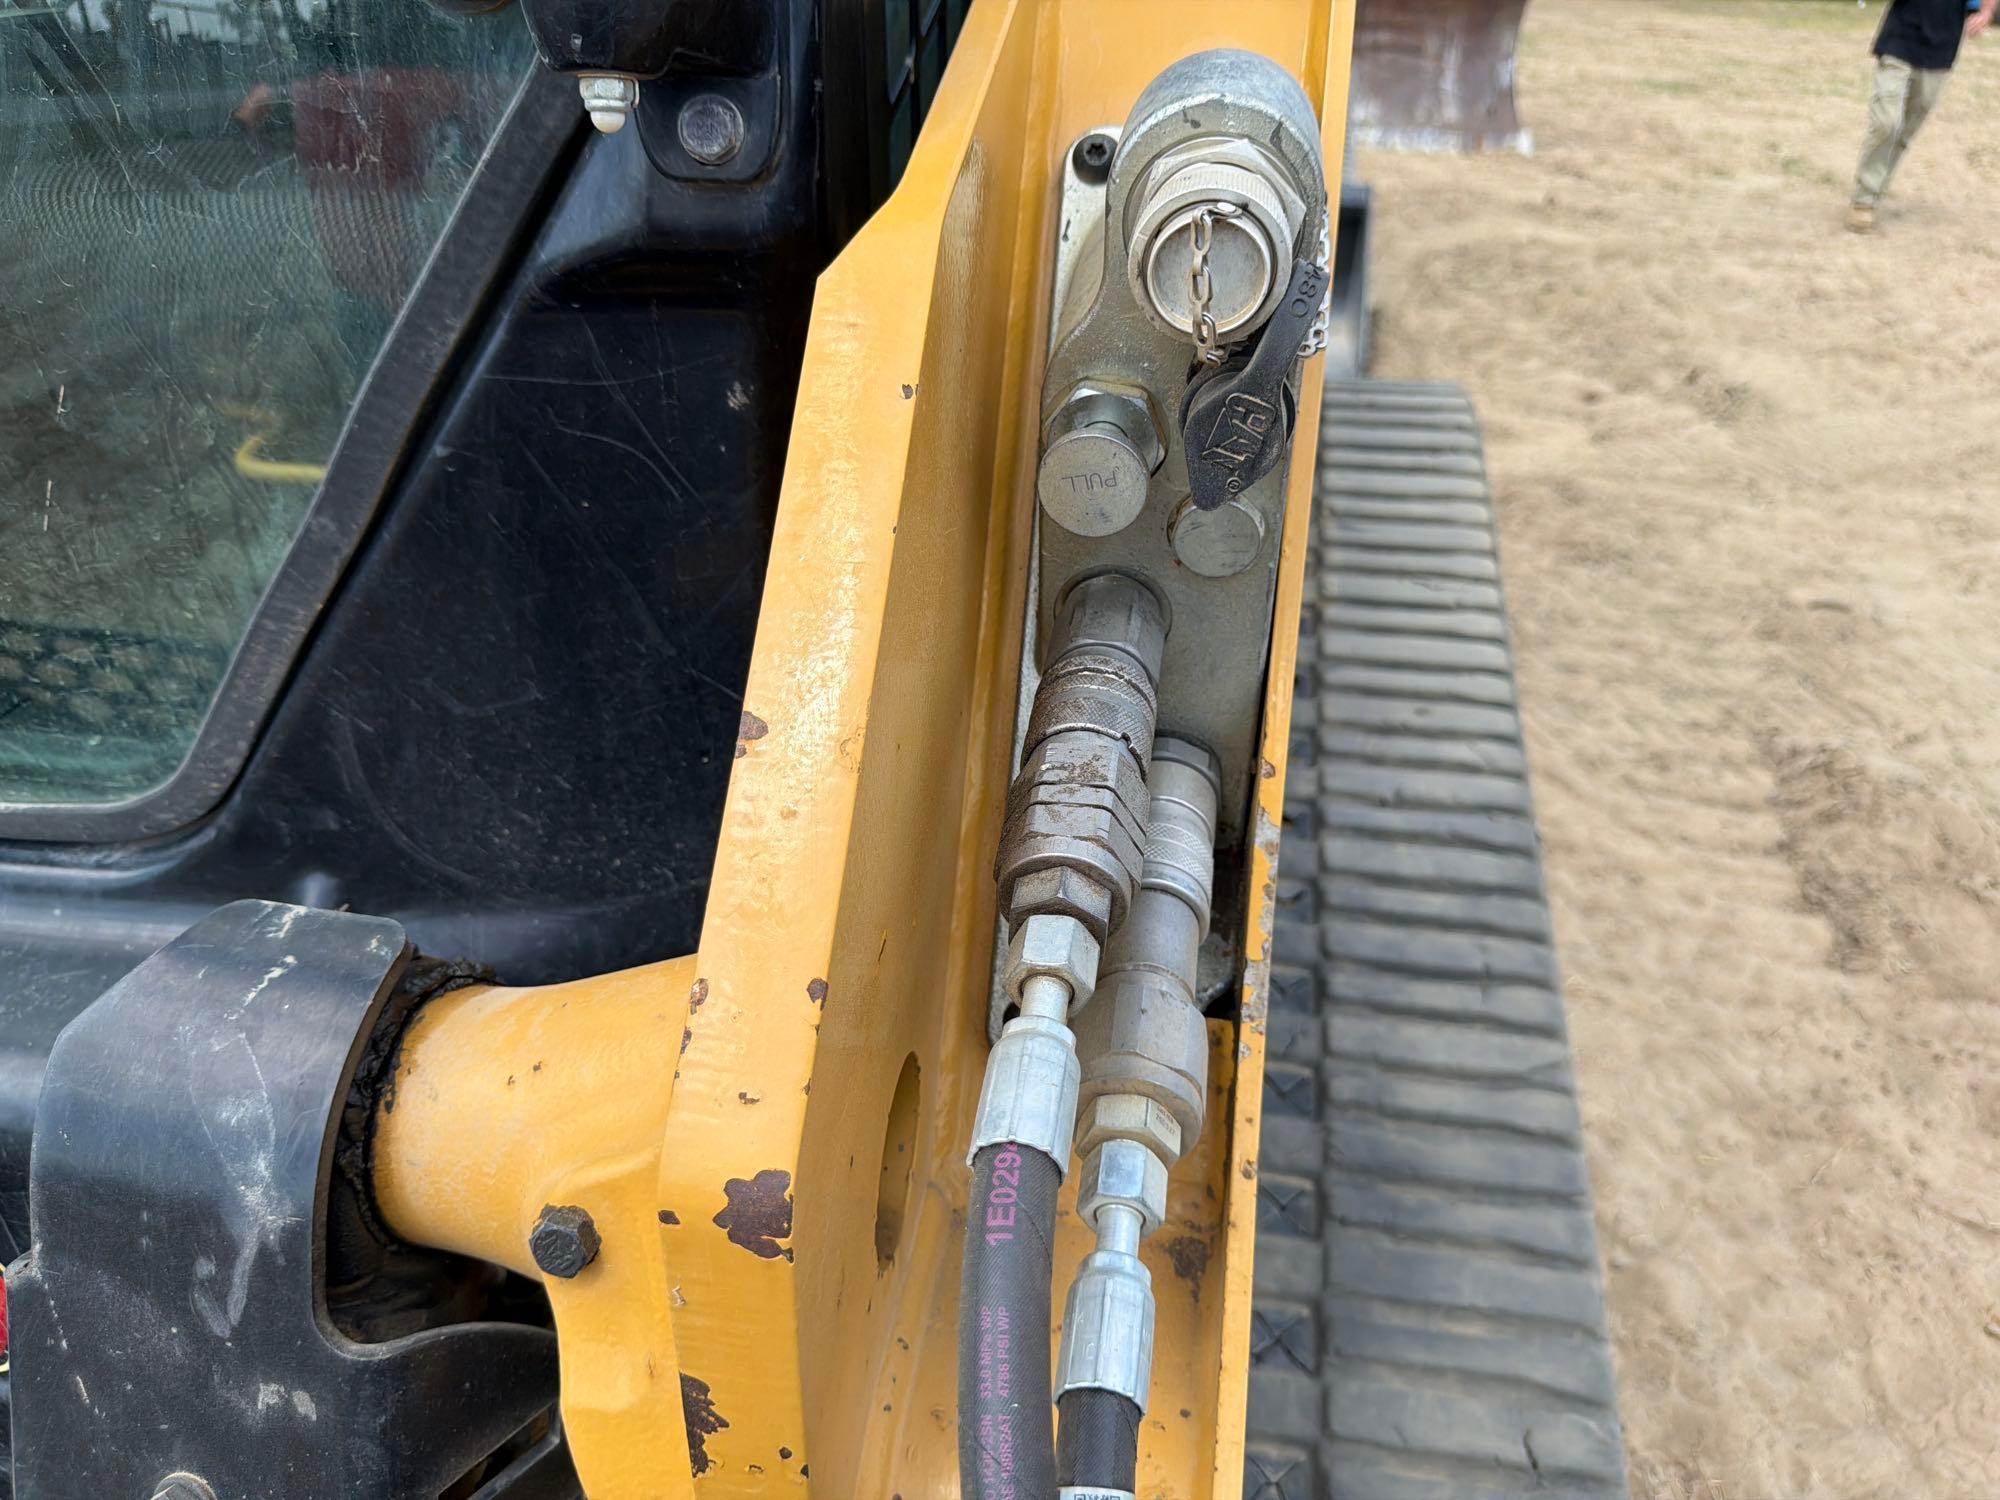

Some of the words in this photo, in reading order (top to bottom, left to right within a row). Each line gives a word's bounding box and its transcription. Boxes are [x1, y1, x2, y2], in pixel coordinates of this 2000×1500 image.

[1061, 470, 1117, 492] PULL
[997, 1306, 1009, 1330] WP
[997, 1334, 1009, 1359] PSI
